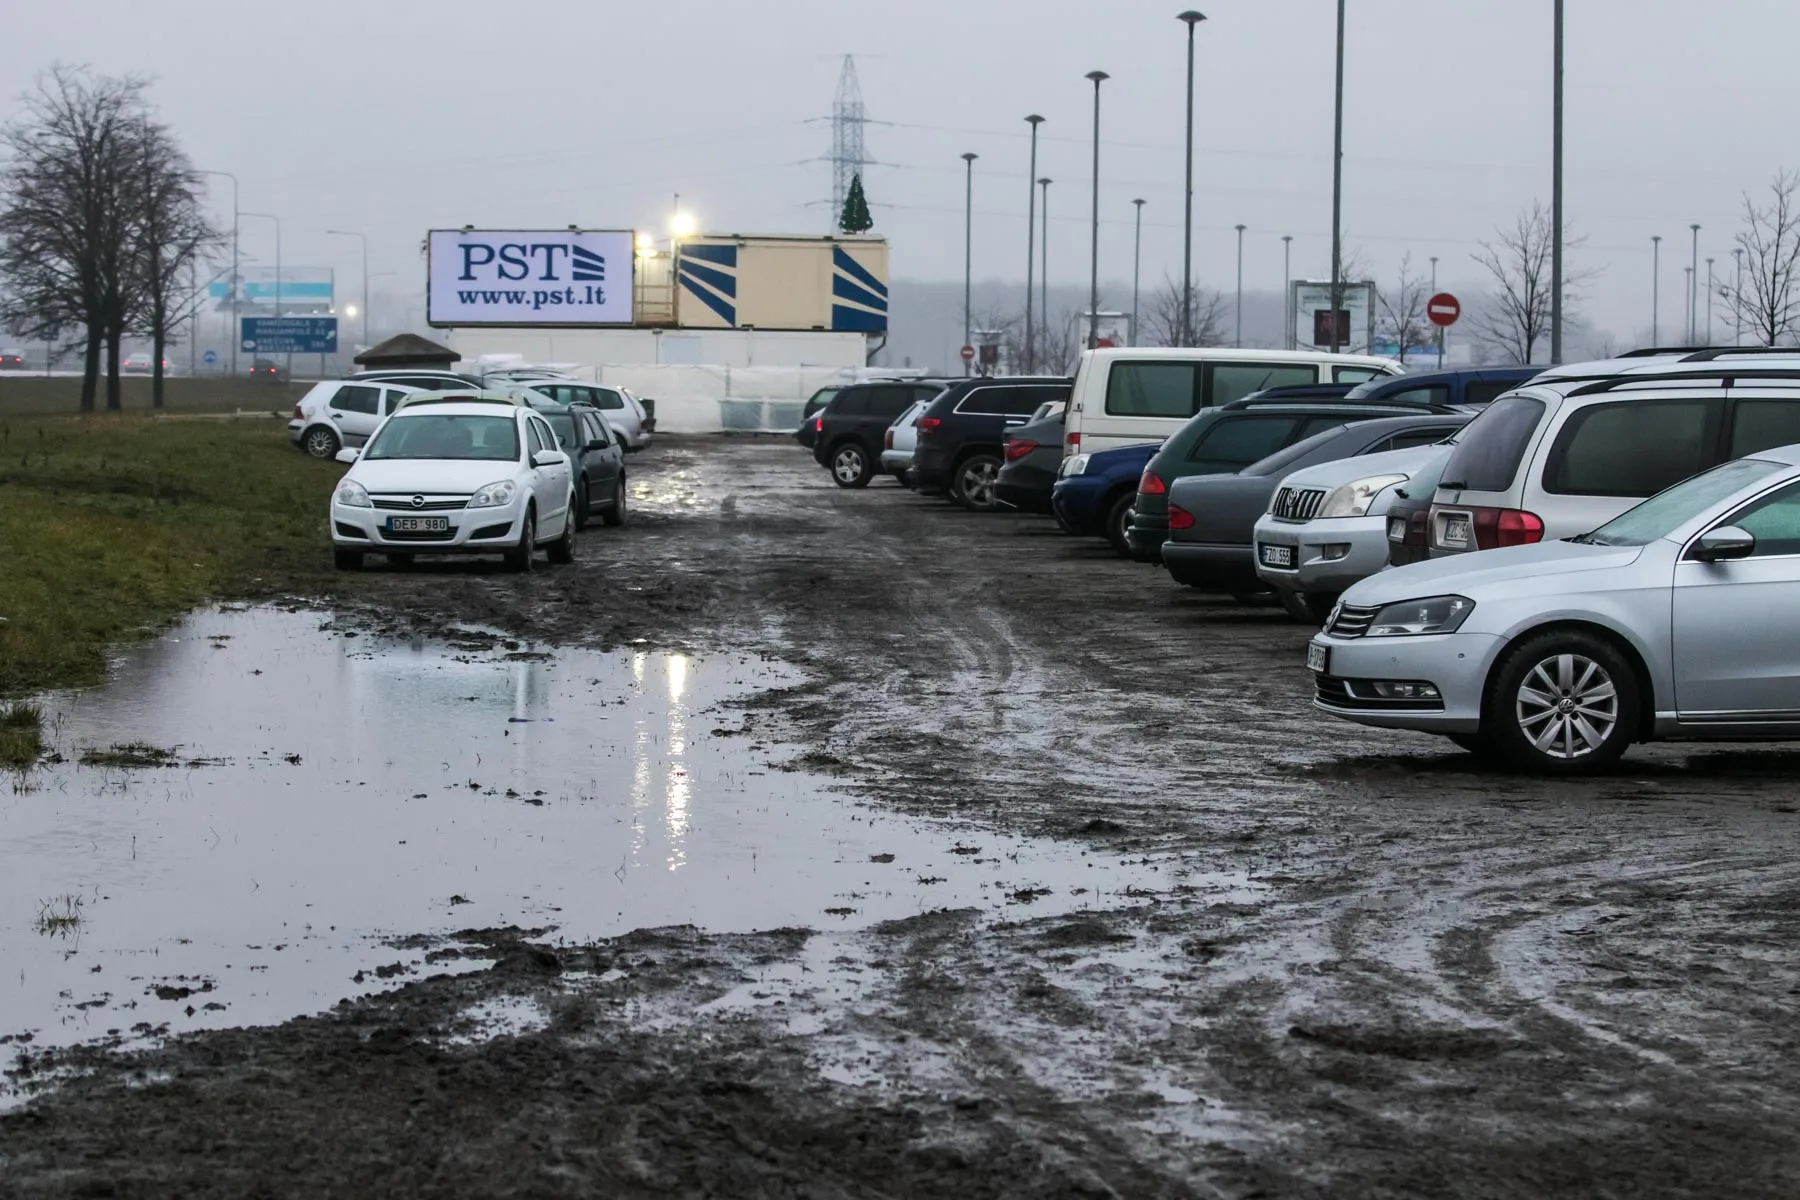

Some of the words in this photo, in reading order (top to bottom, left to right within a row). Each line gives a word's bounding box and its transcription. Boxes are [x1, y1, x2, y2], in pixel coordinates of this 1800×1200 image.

[458, 244, 568, 280] PST
[457, 286, 606, 310] www.pst.lt
[394, 519, 418, 529] DEB
[425, 519, 446, 529] 980
